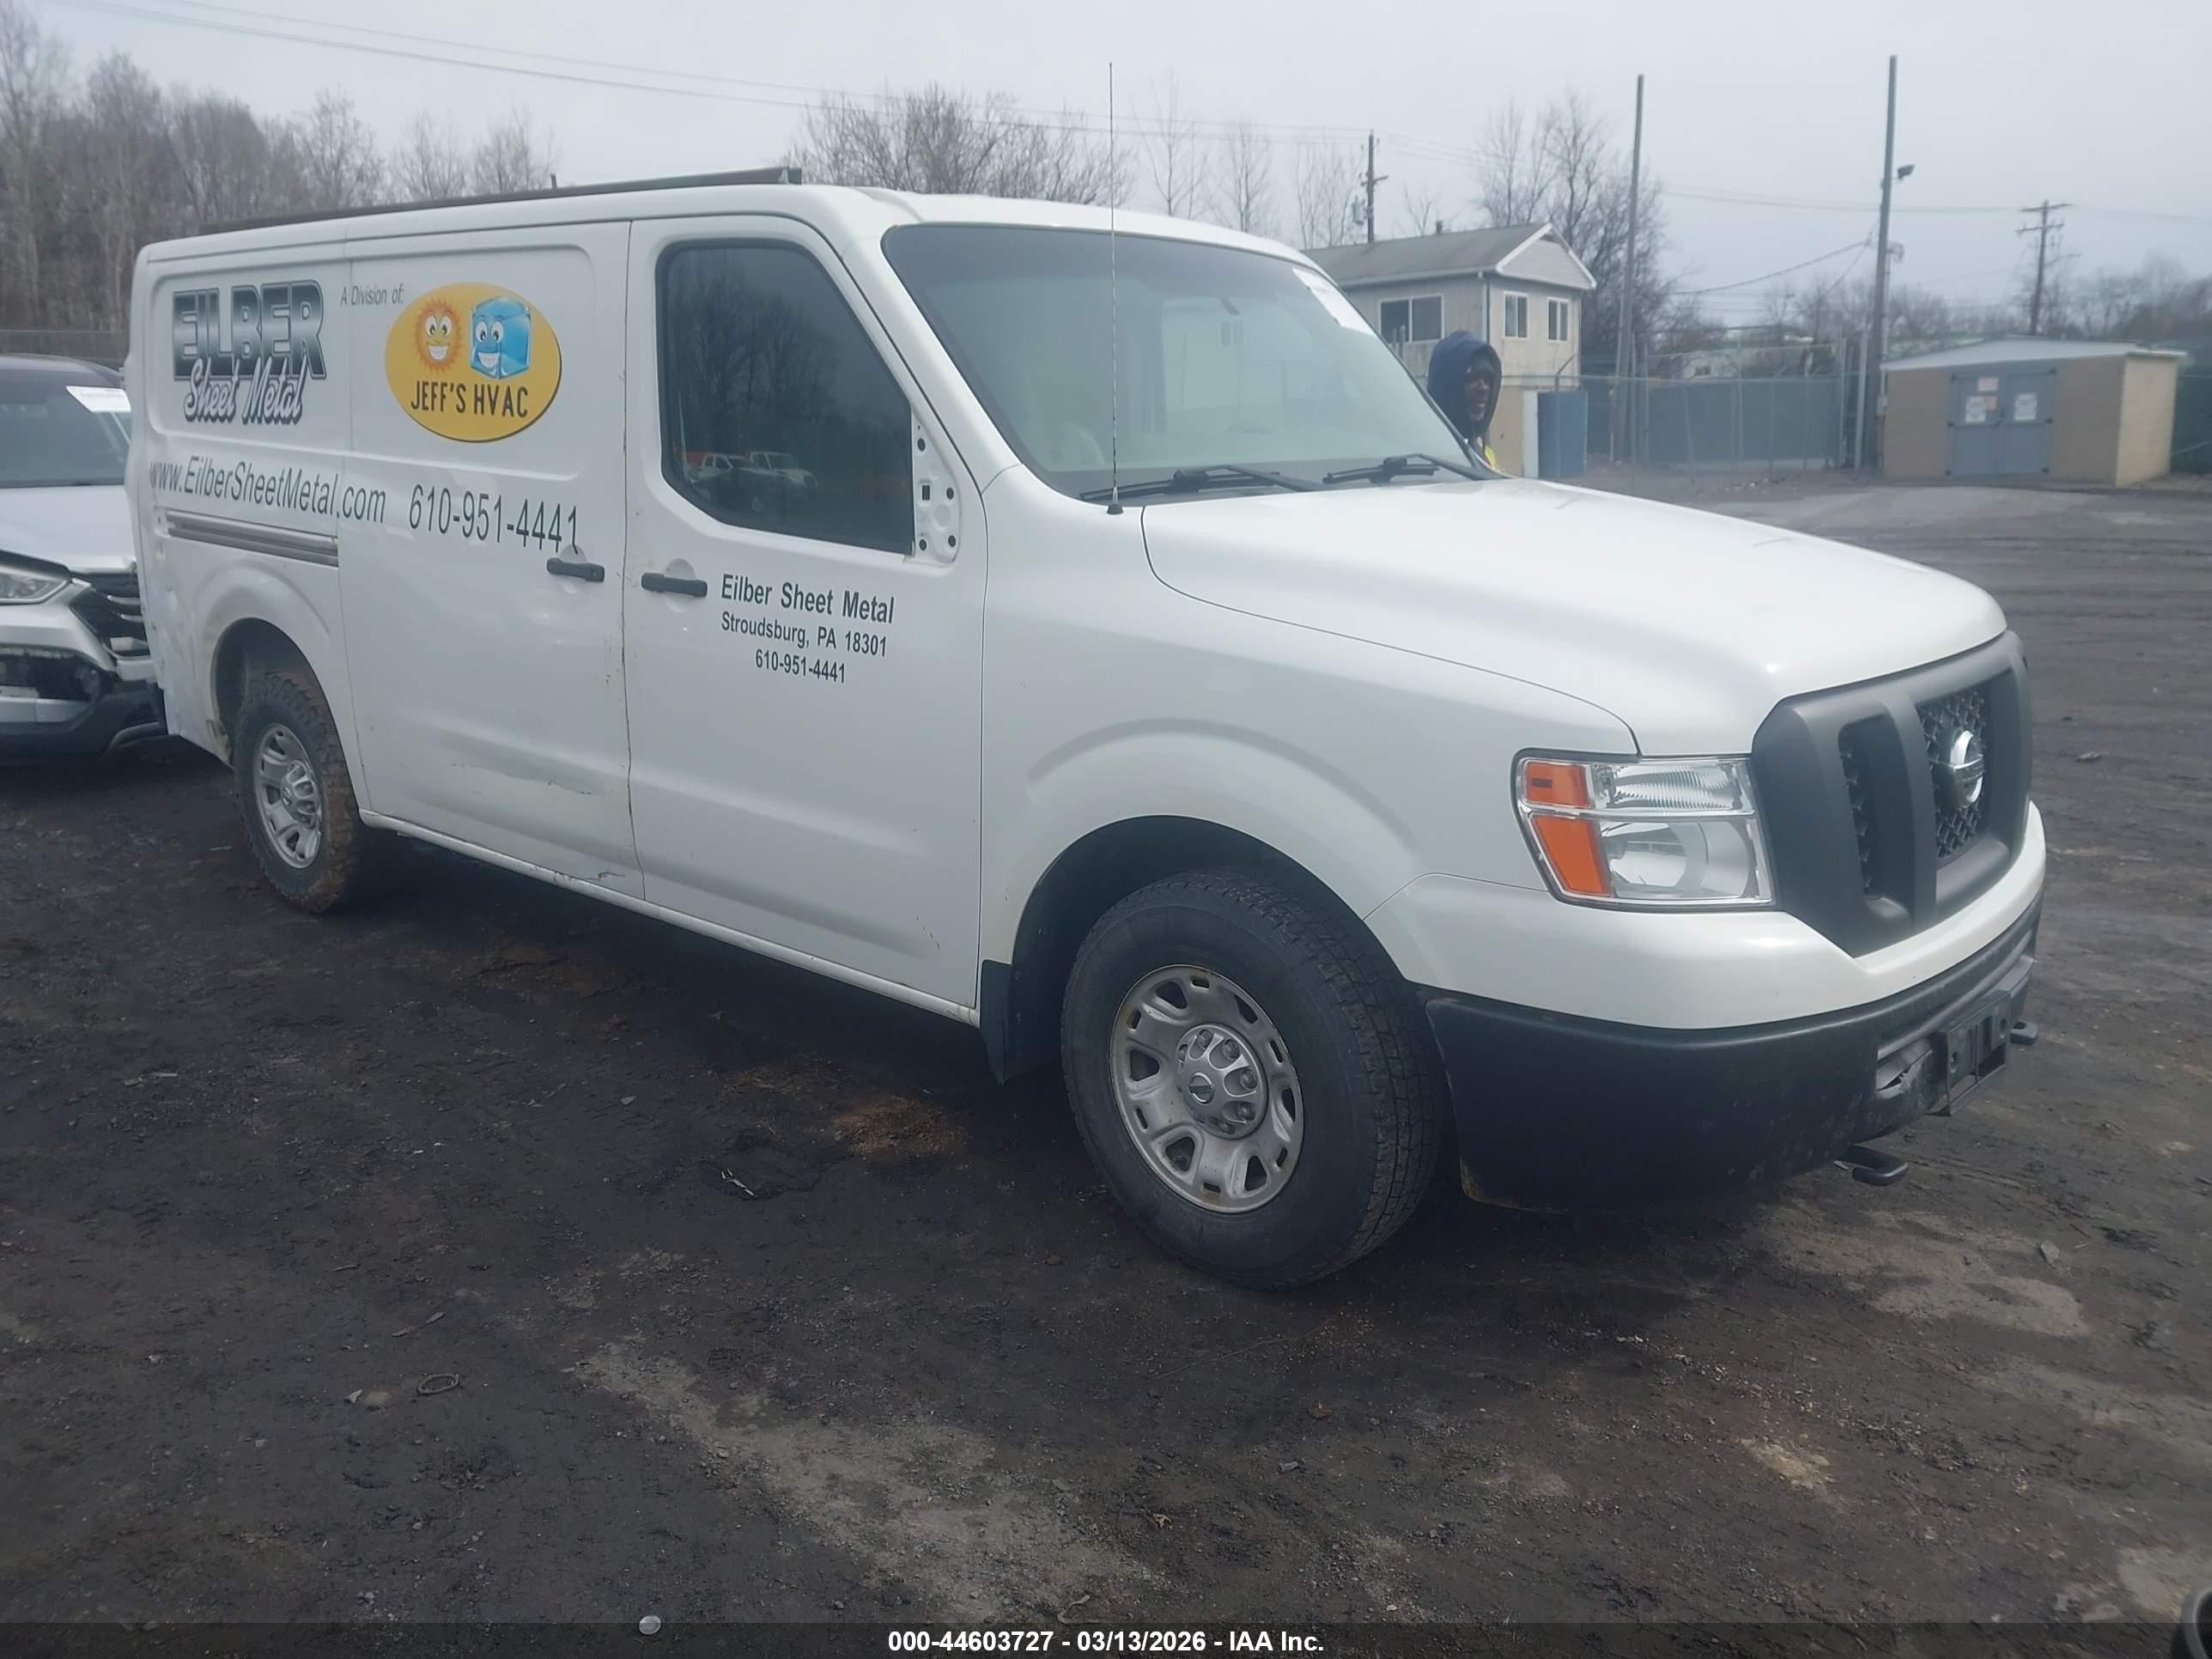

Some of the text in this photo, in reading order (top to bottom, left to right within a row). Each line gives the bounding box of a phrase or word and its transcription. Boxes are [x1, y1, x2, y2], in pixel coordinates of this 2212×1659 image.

[340, 283, 404, 306] A Division of:
[173, 280, 327, 380] EILBER
[184, 354, 308, 425] Sheet Metal
[410, 379, 530, 418] JEFF'S HVAC
[149, 455, 579, 555] www.EilberSheetMetal.com 610-951-4441
[721, 573, 895, 624] Eilber Sheet Metal
[721, 611, 887, 658] Stroudsburg, PA 18301
[755, 648, 846, 684] 610-951-4441
